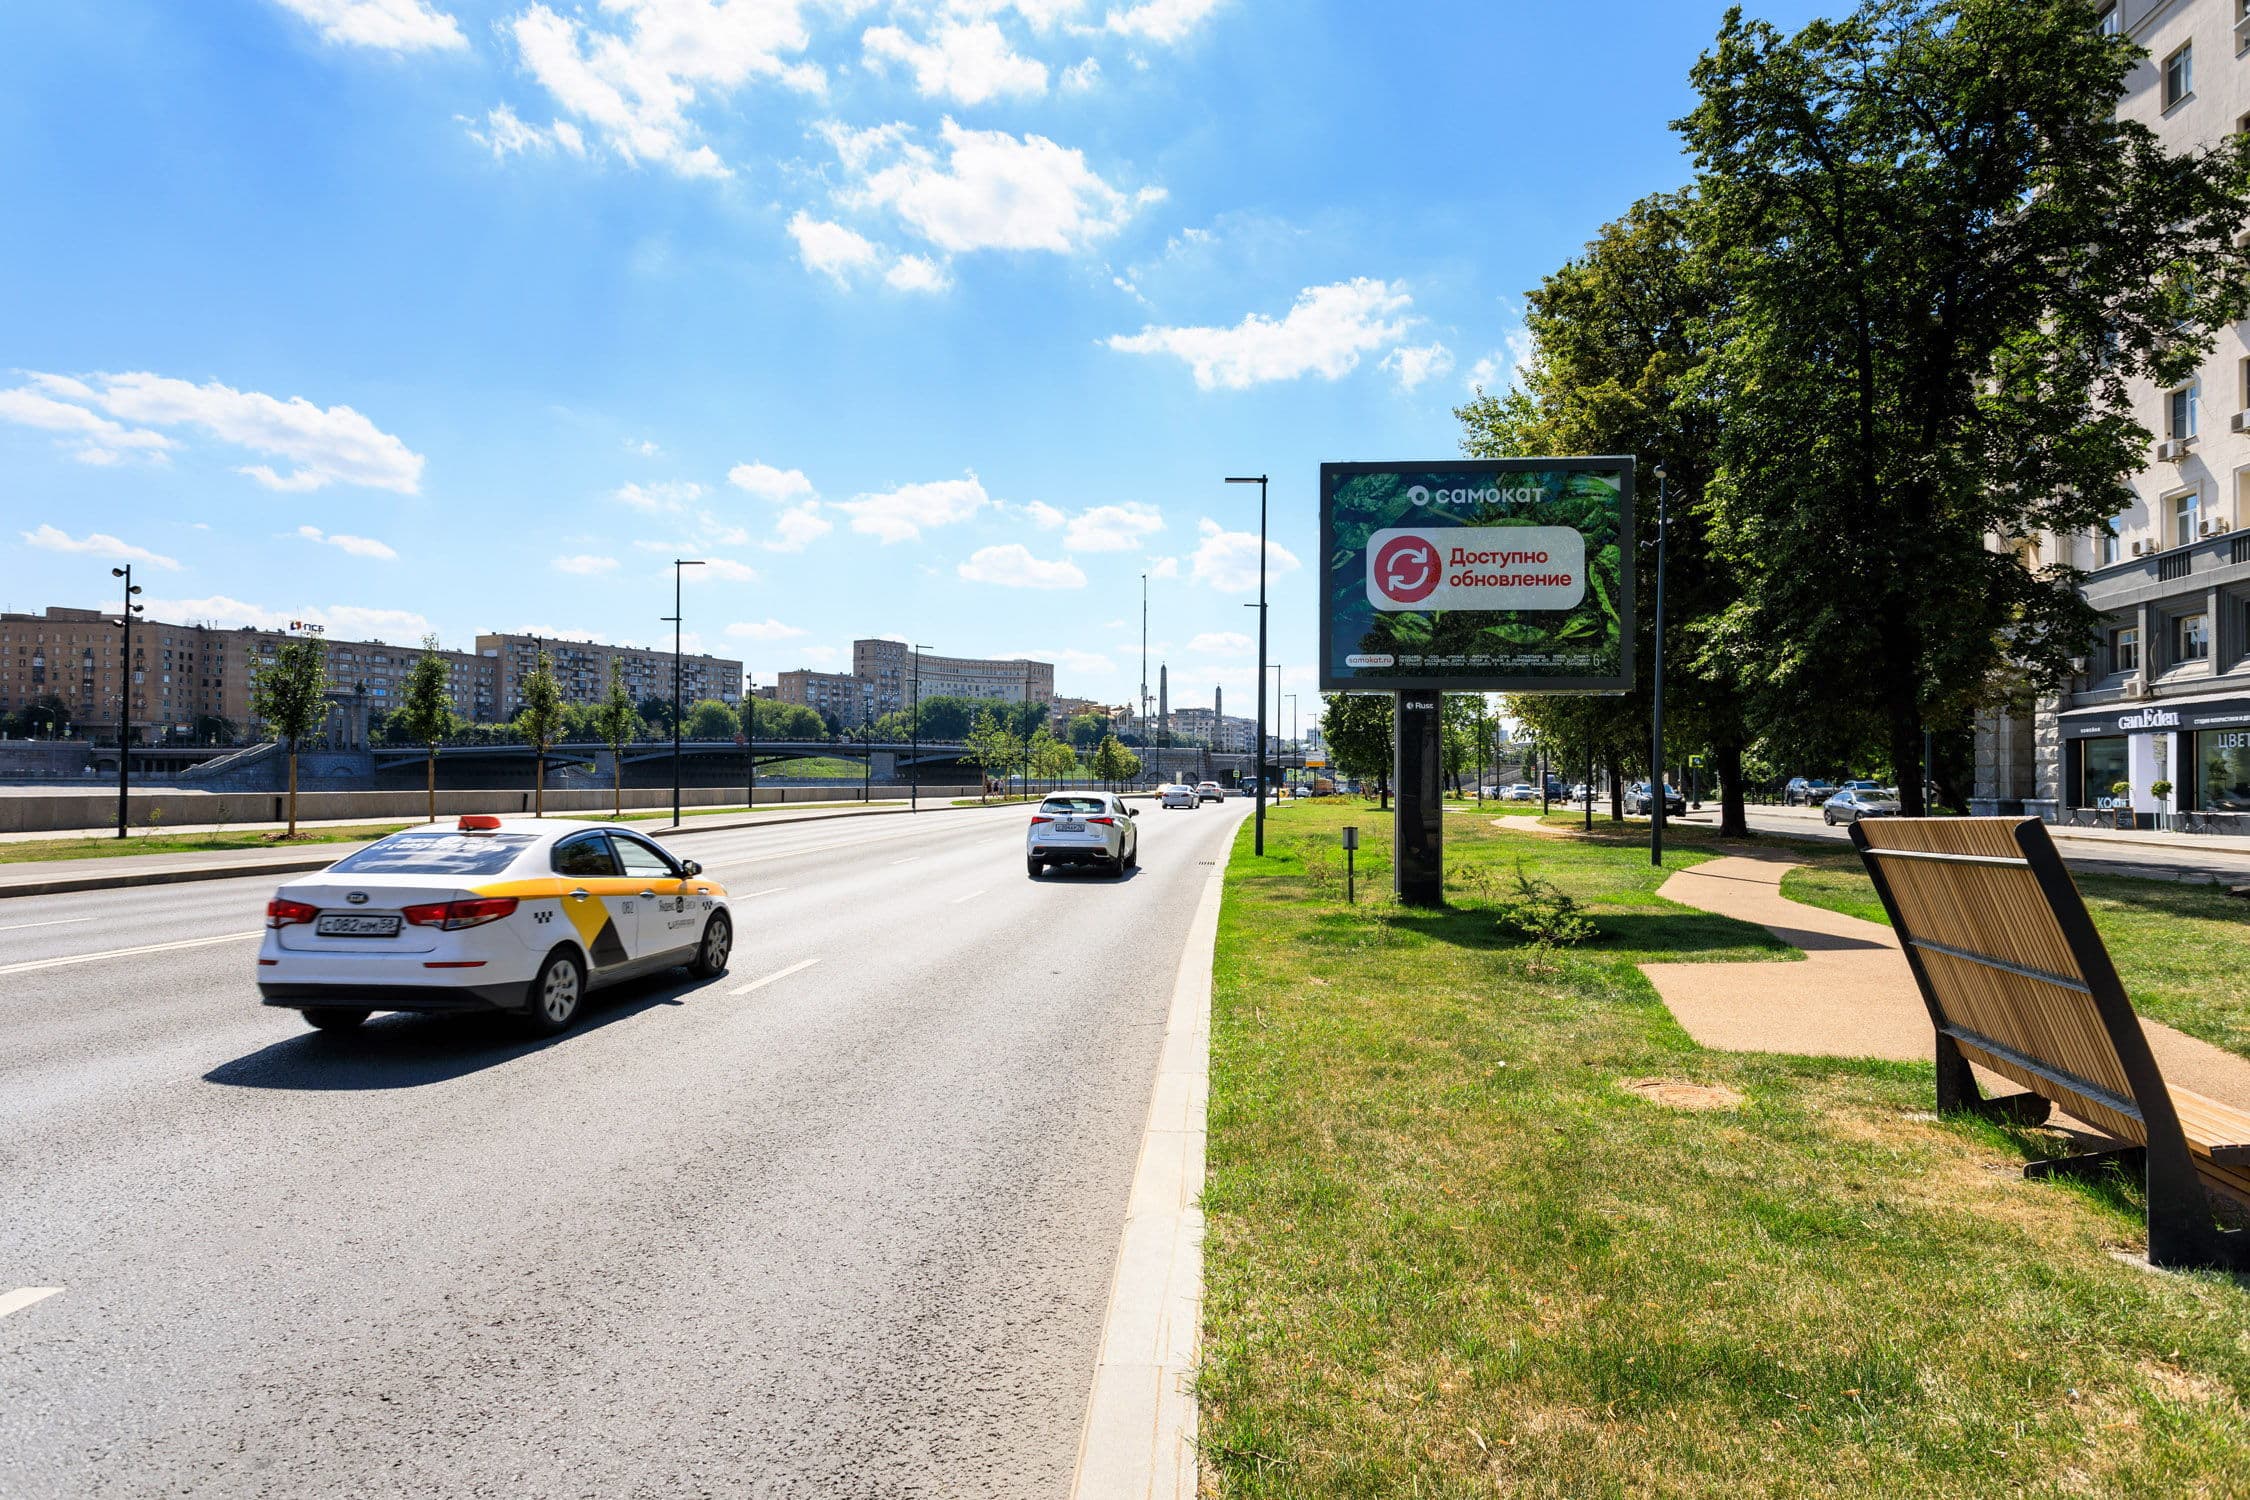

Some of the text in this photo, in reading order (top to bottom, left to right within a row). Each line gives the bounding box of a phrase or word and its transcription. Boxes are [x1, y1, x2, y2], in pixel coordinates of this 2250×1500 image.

[1435, 488, 1545, 503] самокат
[1450, 548, 1549, 568] Доступно
[1450, 570, 1572, 587] обновление
[1349, 656, 1392, 665] samokat.ru
